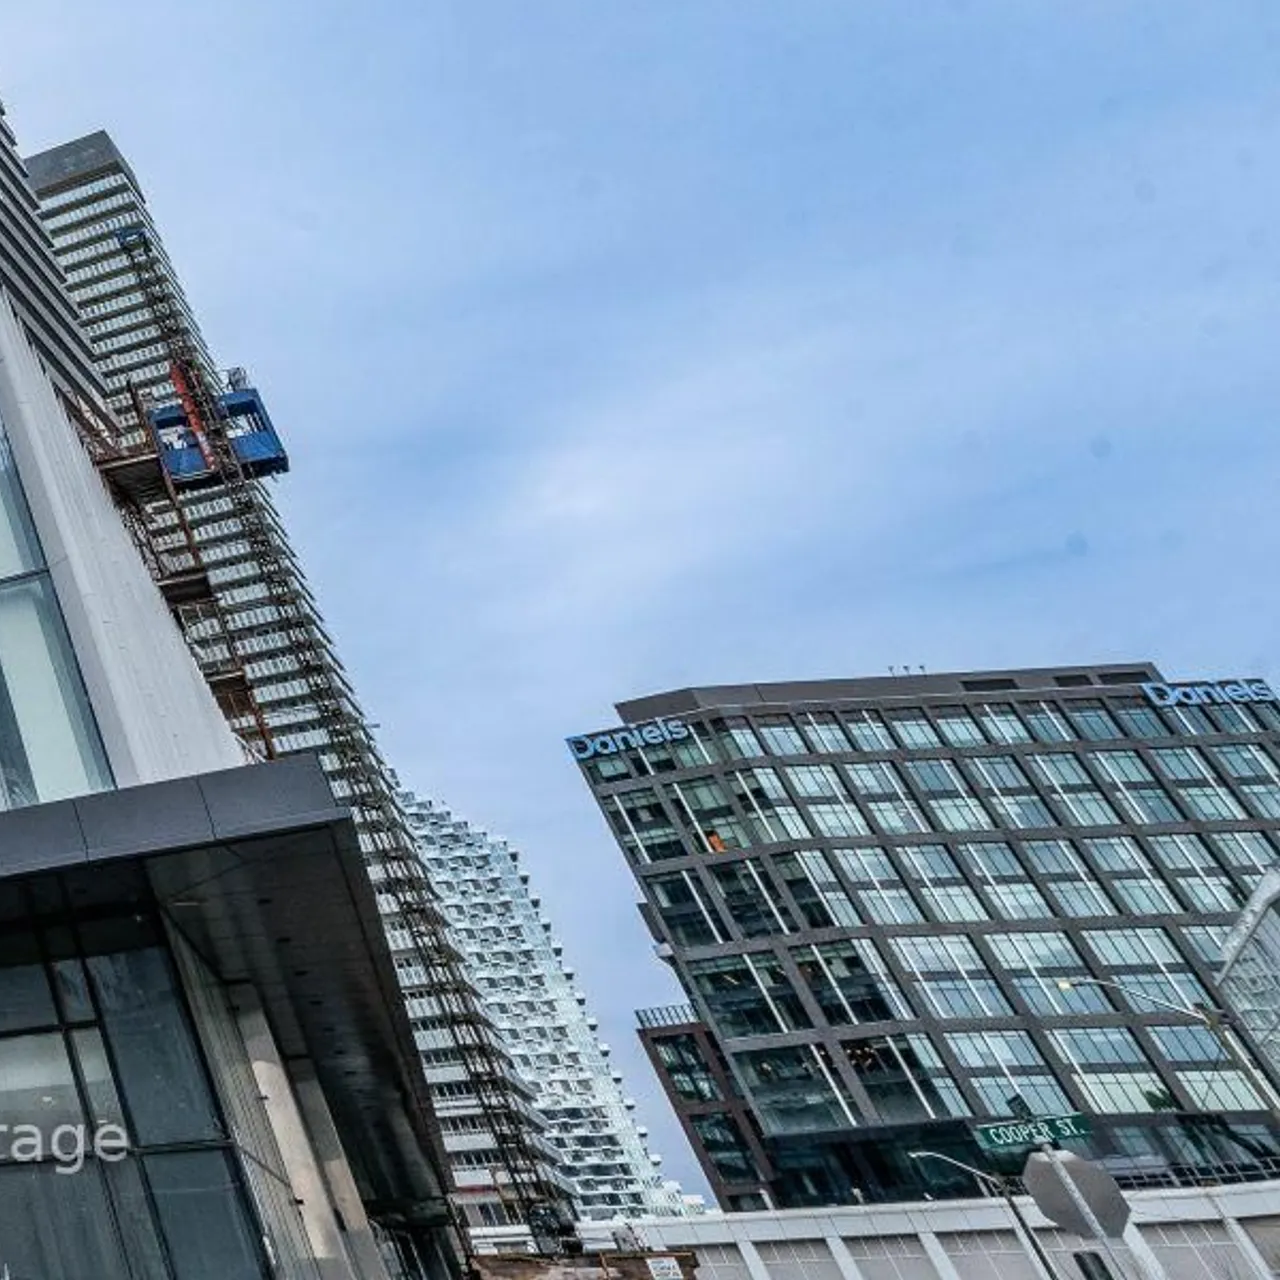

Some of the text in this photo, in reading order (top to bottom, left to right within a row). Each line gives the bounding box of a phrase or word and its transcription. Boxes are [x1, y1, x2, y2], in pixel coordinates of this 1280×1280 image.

[1141, 680, 1276, 707] Daniels
[565, 717, 689, 760] Daniels
[989, 1122, 1055, 1145] COOPER
